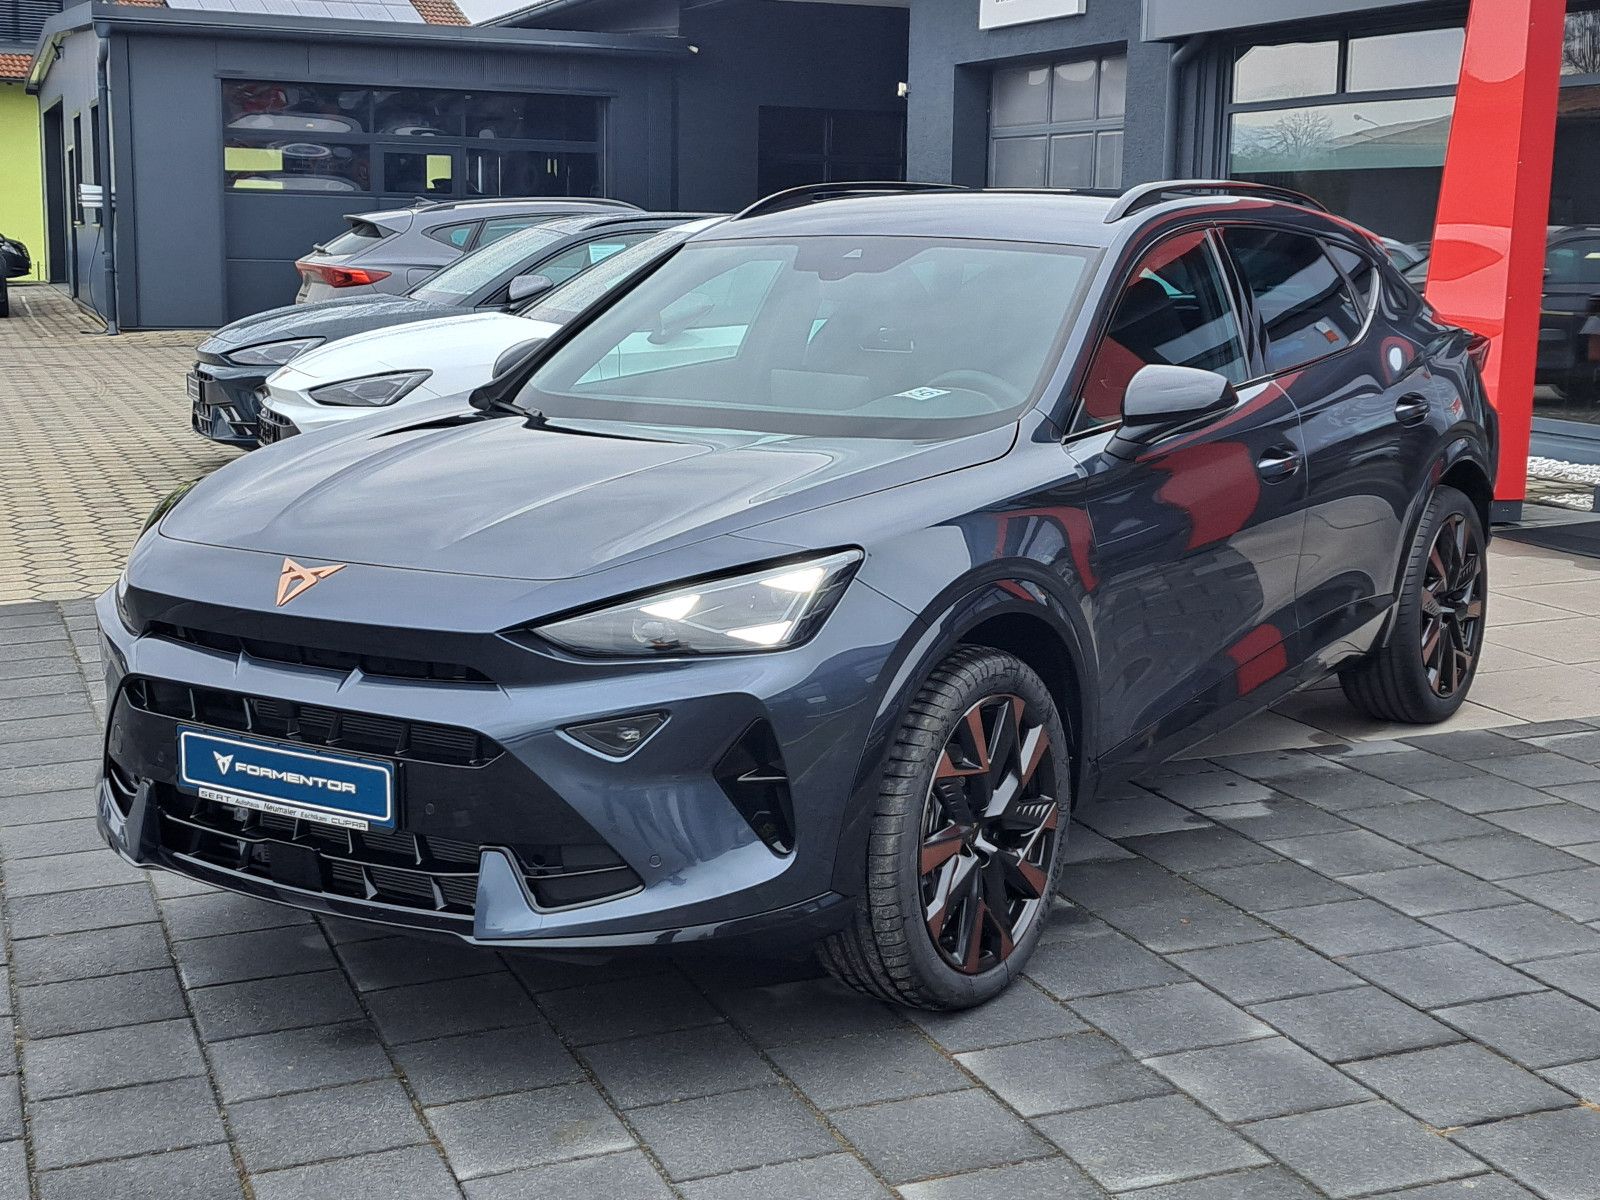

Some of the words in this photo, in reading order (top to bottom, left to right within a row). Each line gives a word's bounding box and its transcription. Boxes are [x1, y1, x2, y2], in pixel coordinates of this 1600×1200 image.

[235, 762, 356, 794] FORMENTOR
[201, 790, 231, 802] SEAT
[235, 799, 260, 809] Autohaus
[331, 817, 366, 830] CUPRA
